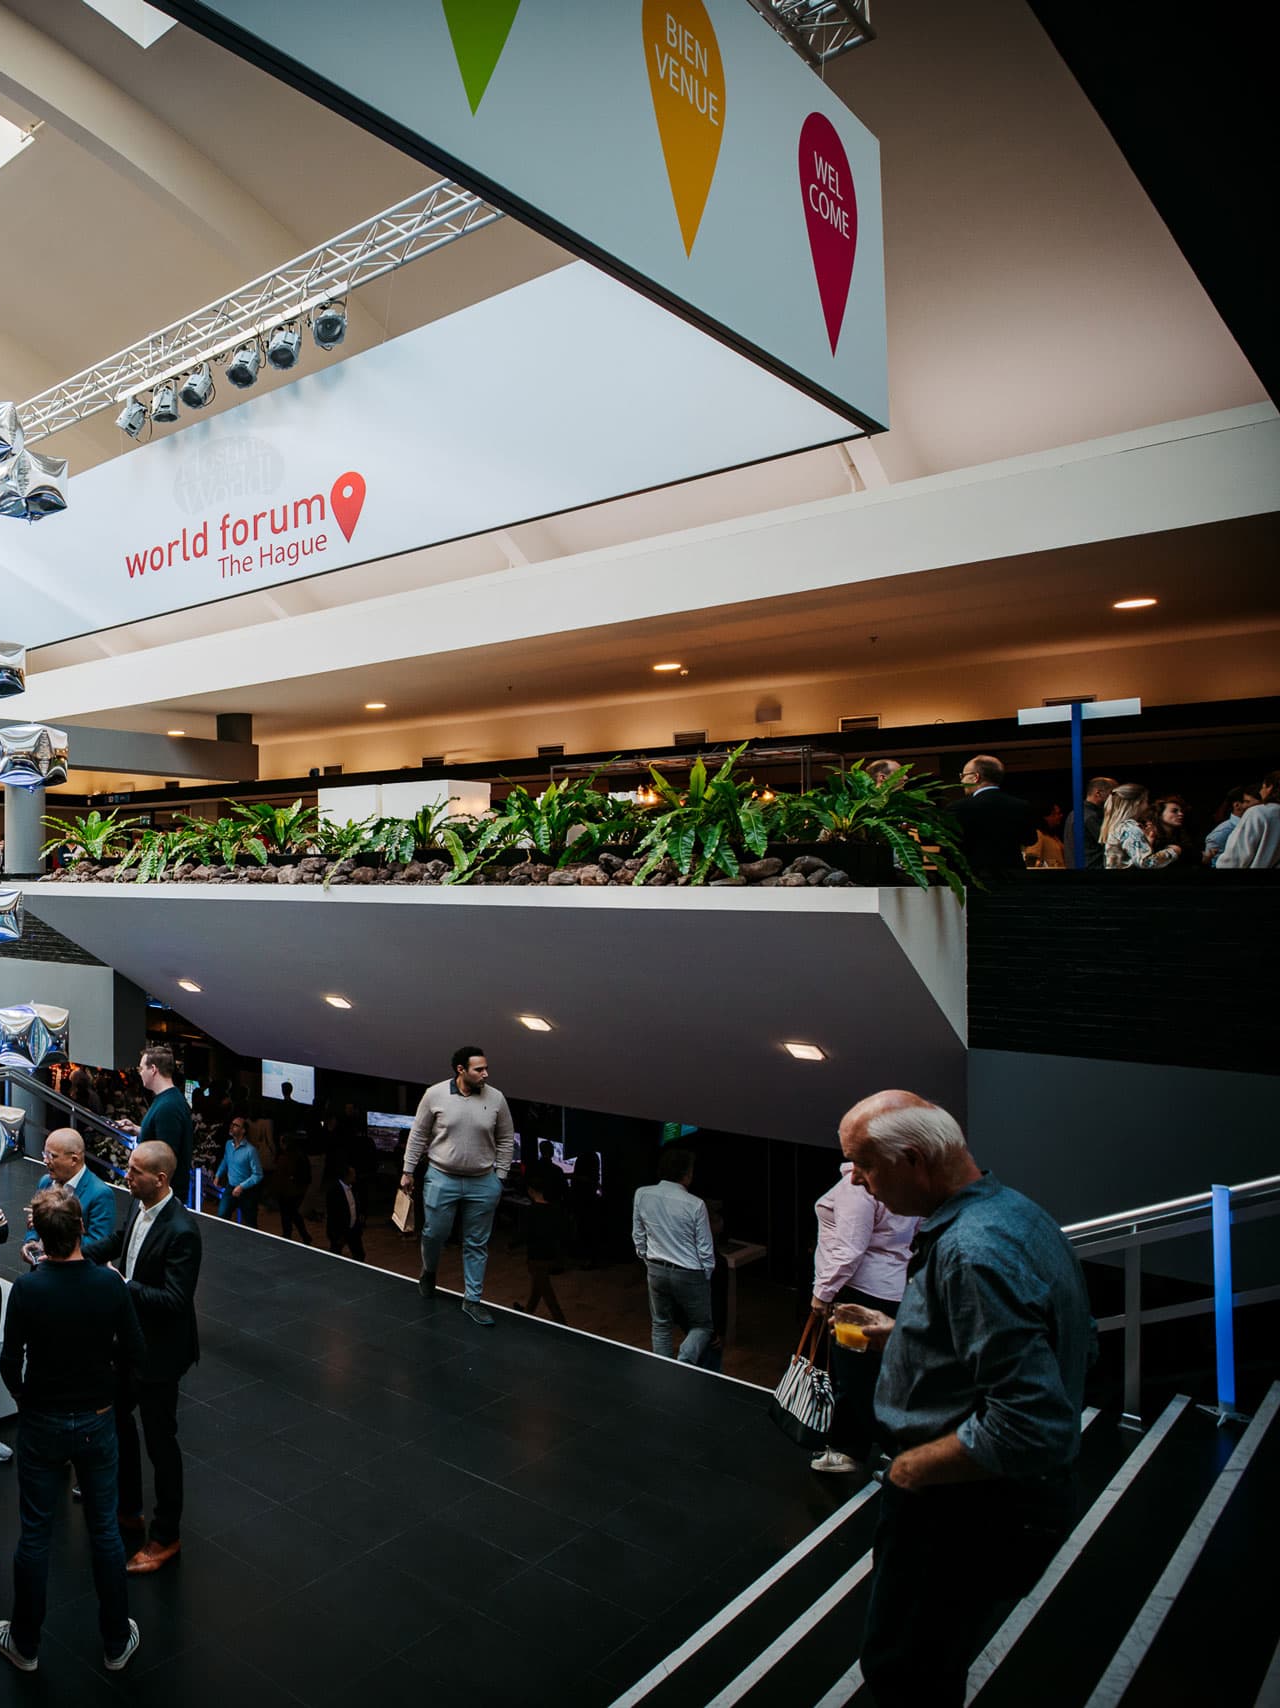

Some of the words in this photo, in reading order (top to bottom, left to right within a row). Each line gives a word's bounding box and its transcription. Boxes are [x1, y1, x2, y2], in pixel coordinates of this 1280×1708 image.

[666, 13, 708, 79] BIEN
[654, 43, 719, 127] VENUE
[813, 150, 844, 201] WEL
[809, 183, 850, 240] COME
[125, 520, 209, 579] world
[219, 493, 326, 551] forum
[217, 554, 254, 579] The
[259, 533, 328, 568] Hague
